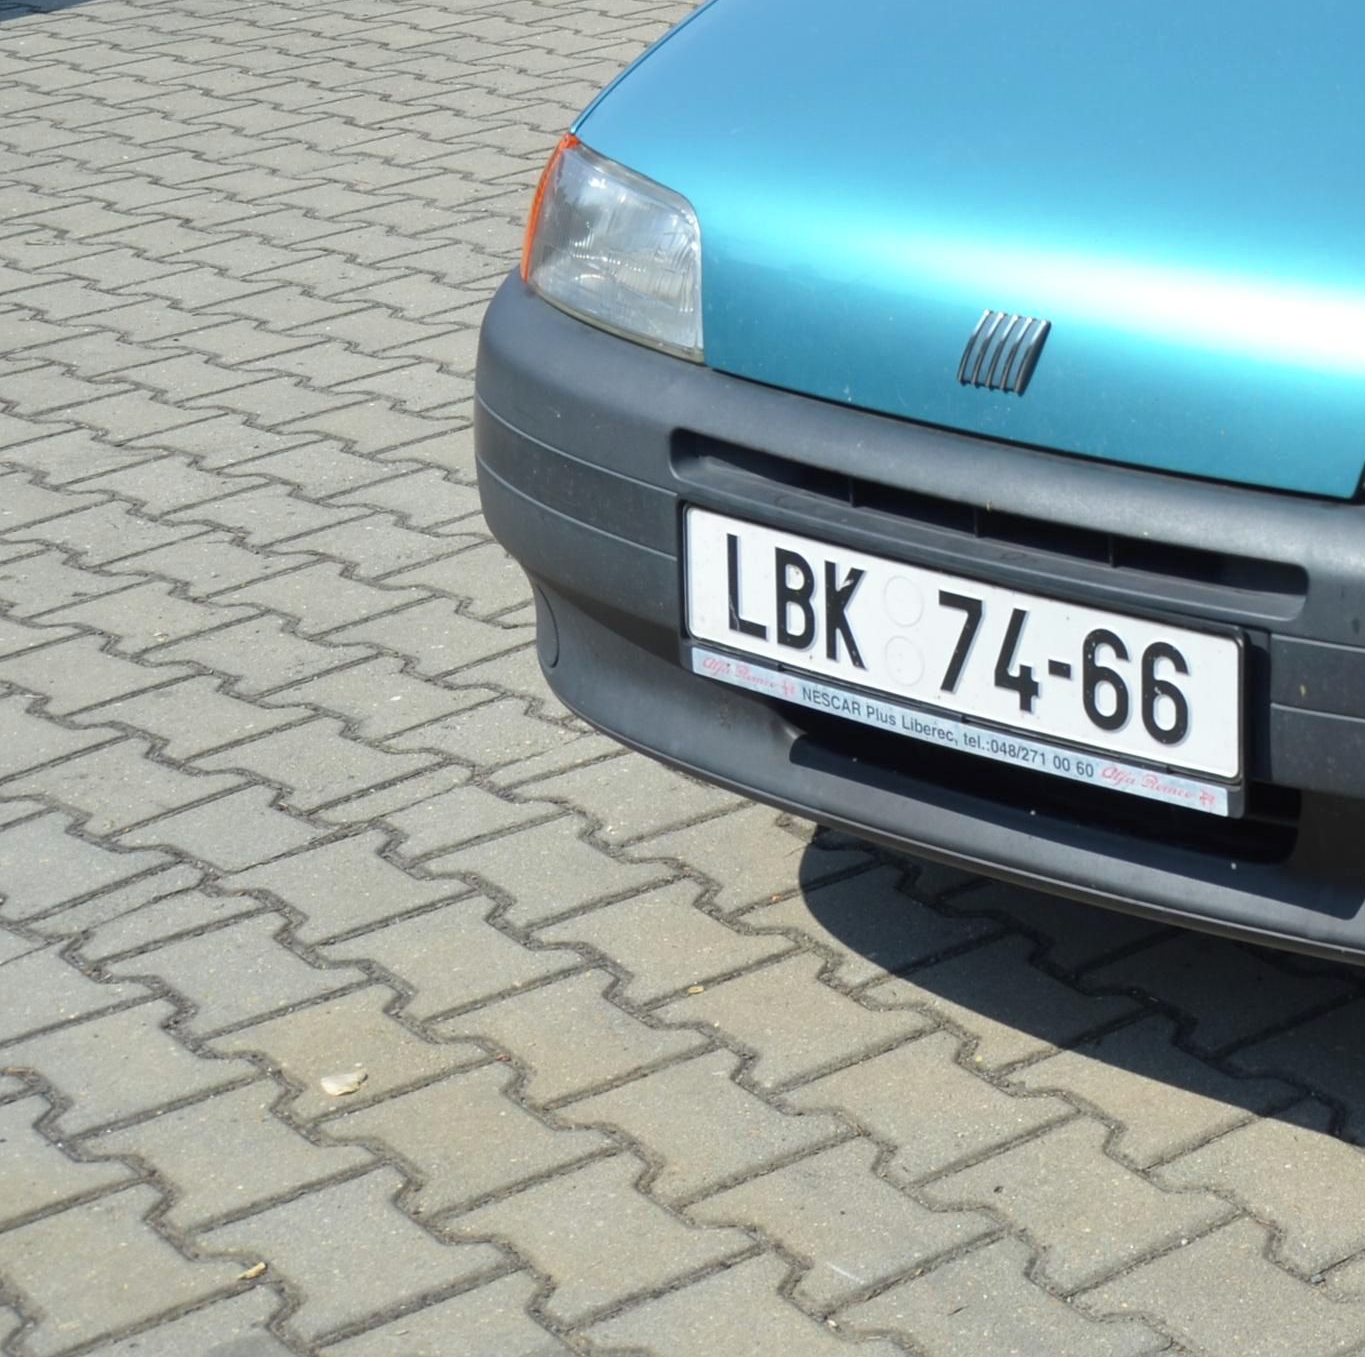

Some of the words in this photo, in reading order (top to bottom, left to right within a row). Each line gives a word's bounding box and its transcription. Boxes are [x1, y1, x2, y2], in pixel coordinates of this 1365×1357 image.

[726, 533, 868, 671] LBK
[938, 590, 1190, 746] 74-66
[802, 686, 862, 716] NESCAR
[866, 704, 897, 726] Plus
[901, 714, 959, 747] Liberec,
[963, 732, 1047, 766] tel.:048/271
[1053, 755, 1071, 772] 00
[1076, 760, 1095, 779] 60
